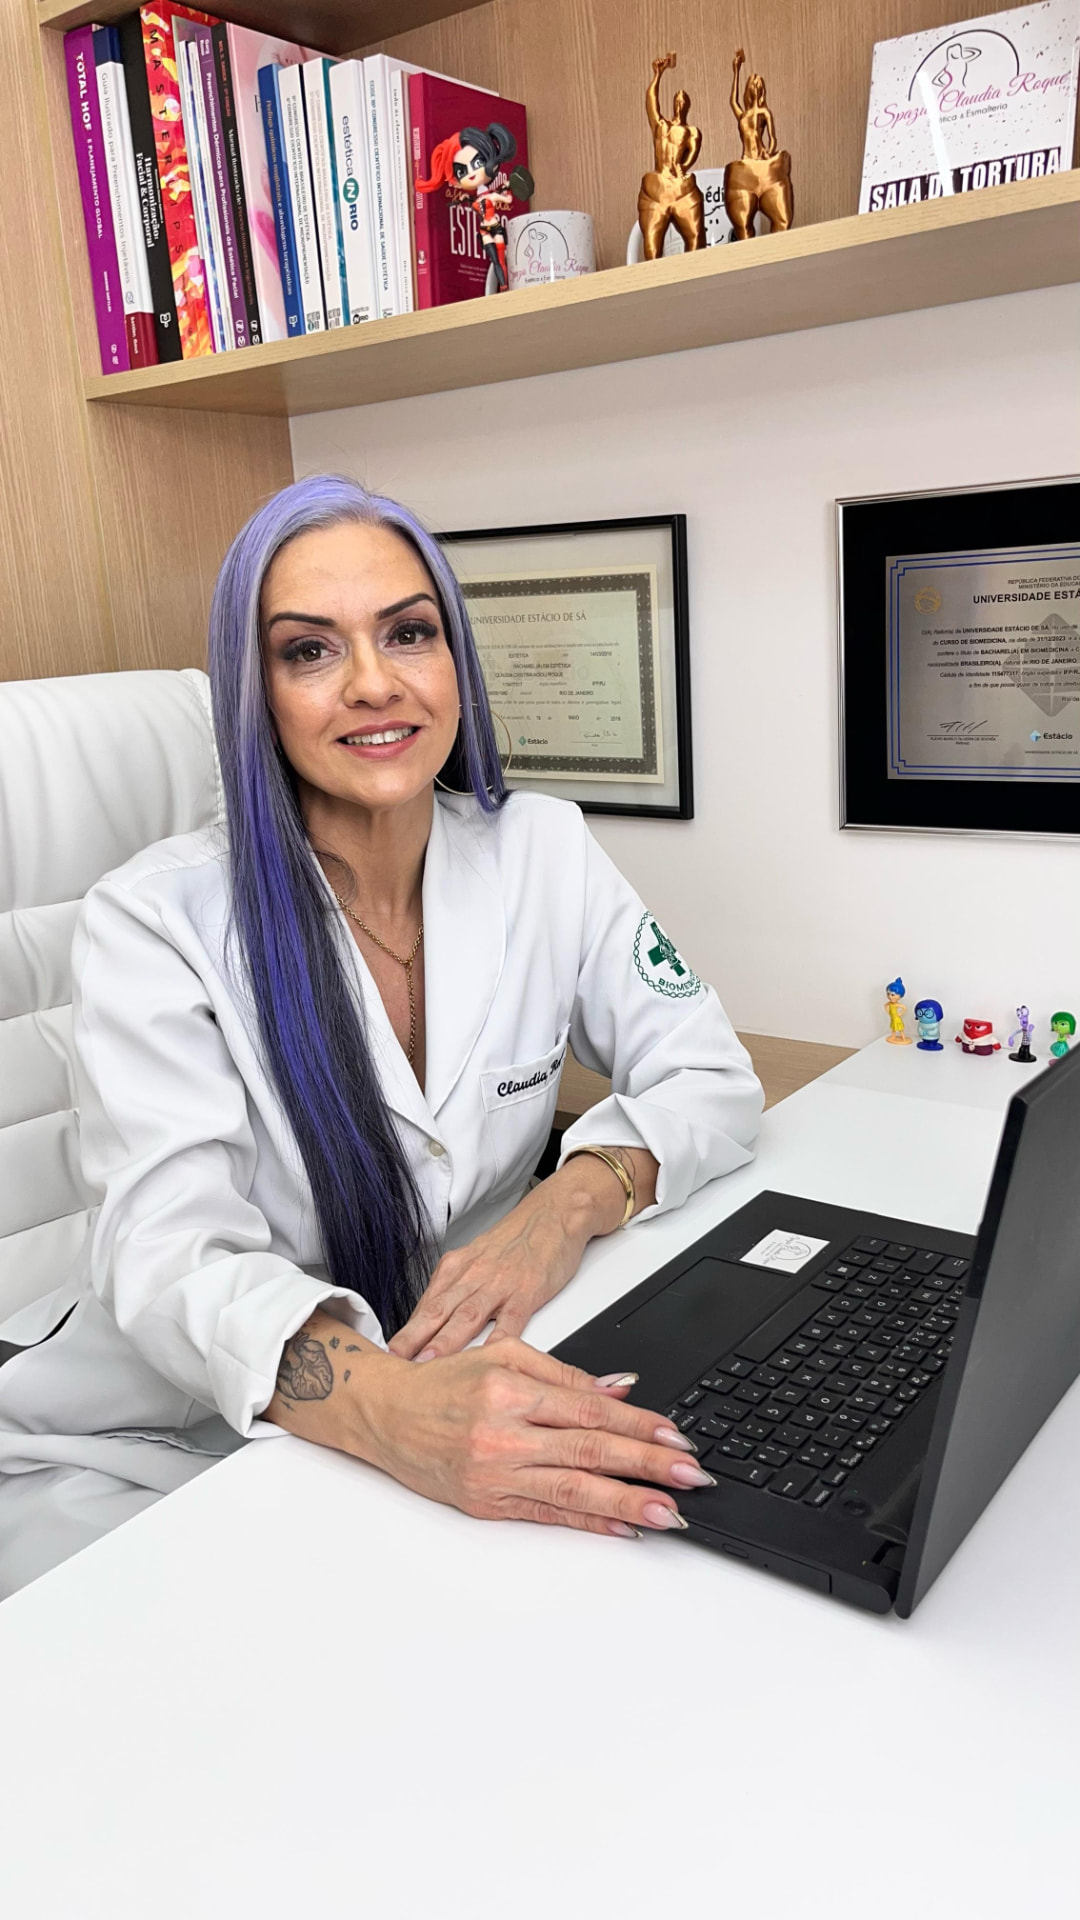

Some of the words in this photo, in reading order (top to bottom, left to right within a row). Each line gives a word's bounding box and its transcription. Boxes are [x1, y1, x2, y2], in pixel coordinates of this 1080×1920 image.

[74, 52, 88, 98] TOTAL
[100, 72, 109, 95] Guia
[80, 101, 92, 130] HOF
[873, 103, 928, 128] Spazi
[939, 85, 1000, 112] Claudia
[1007, 72, 1070, 96] Roque
[966, 104, 1008, 118] Esmalteria
[103, 97, 114, 138] Ilustrado
[108, 141, 116, 161] para
[227, 128, 236, 156] Manual
[341, 115, 355, 176] estética
[86, 144, 99, 204] PLANEJAMENTO
[136, 152, 146, 184] Facial
[205, 72, 218, 132] Preenchimentos
[212, 133, 223, 169] Dérmicos
[220, 188, 231, 234] Profissionais
[227, 246, 236, 275] Estética
[872, 180, 922, 211] SALA
[960, 148, 1060, 194] TORTURA
[111, 164, 126, 238] Preenchimentos
[140, 187, 147, 196] &
[144, 157, 161, 239] Harmonização:
[346, 181, 356, 199] IN
[94, 207, 103, 238] GLOBAL
[141, 198, 154, 247] Corporal
[277, 208, 288, 250] abordagens
[348, 203, 358, 230] RIO
[119, 240, 131, 283] Injetáveis
[973, 590, 1050, 604] UNIVERSIDADE
[470, 614, 525, 624] UNIVERSIDADE
[528, 611, 560, 622] ESTÁCIO
[563, 612, 573, 621] DE
[576, 610, 587, 621] SÁ
[497, 1070, 548, 1097] Claudia
